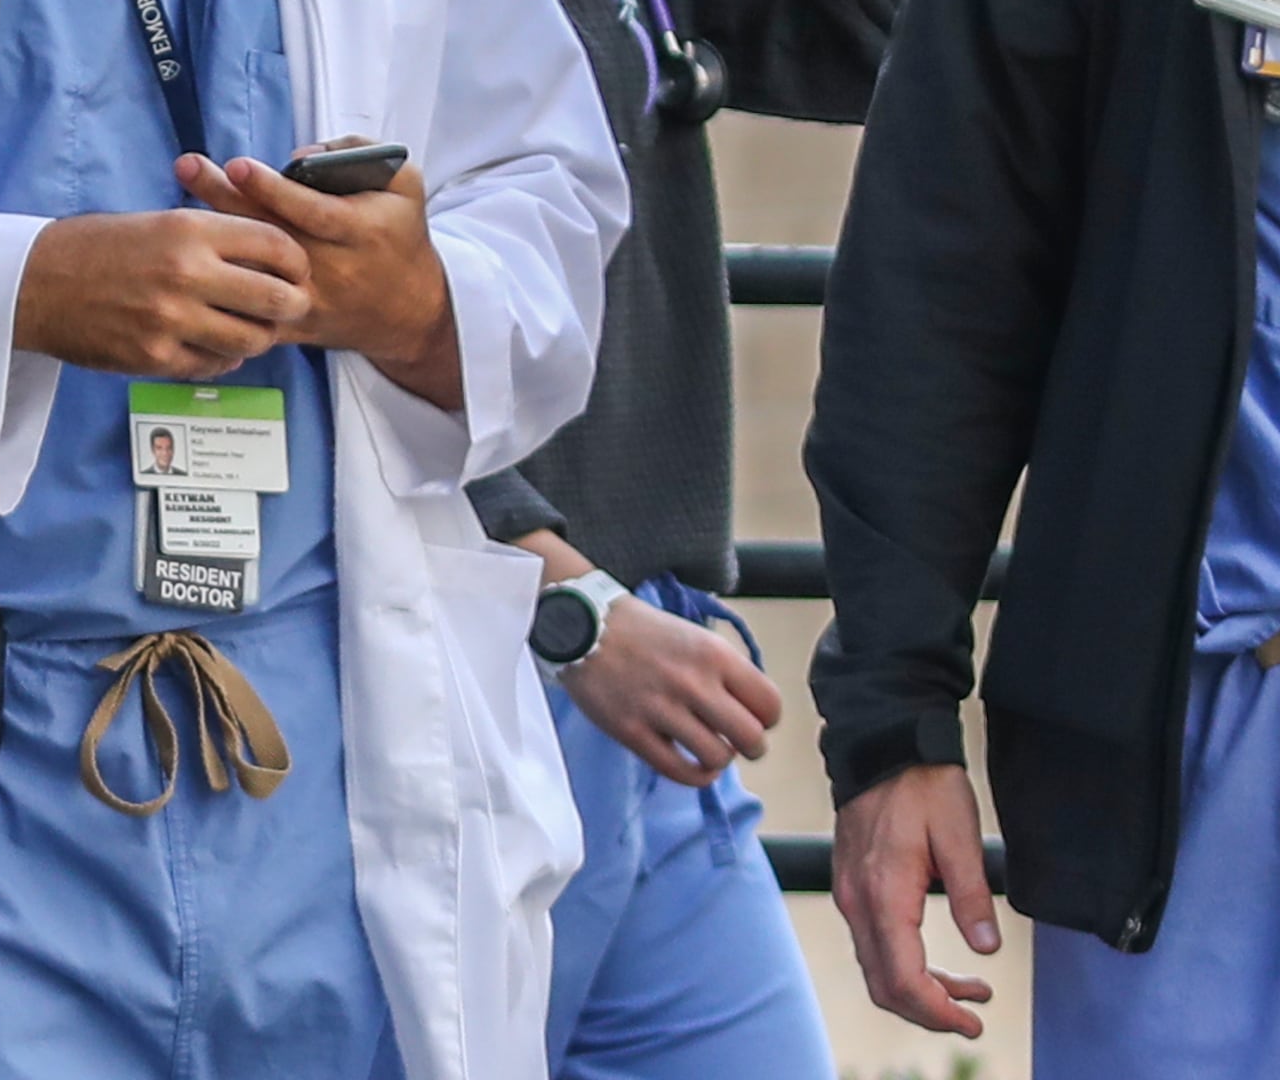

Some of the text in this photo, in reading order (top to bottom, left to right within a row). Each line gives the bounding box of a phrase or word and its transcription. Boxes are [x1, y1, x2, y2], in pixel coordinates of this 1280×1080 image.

[164, 493, 215, 503] KEYWAN
[156, 560, 242, 589] RESIDENT
[161, 581, 236, 609] DOCTOR
